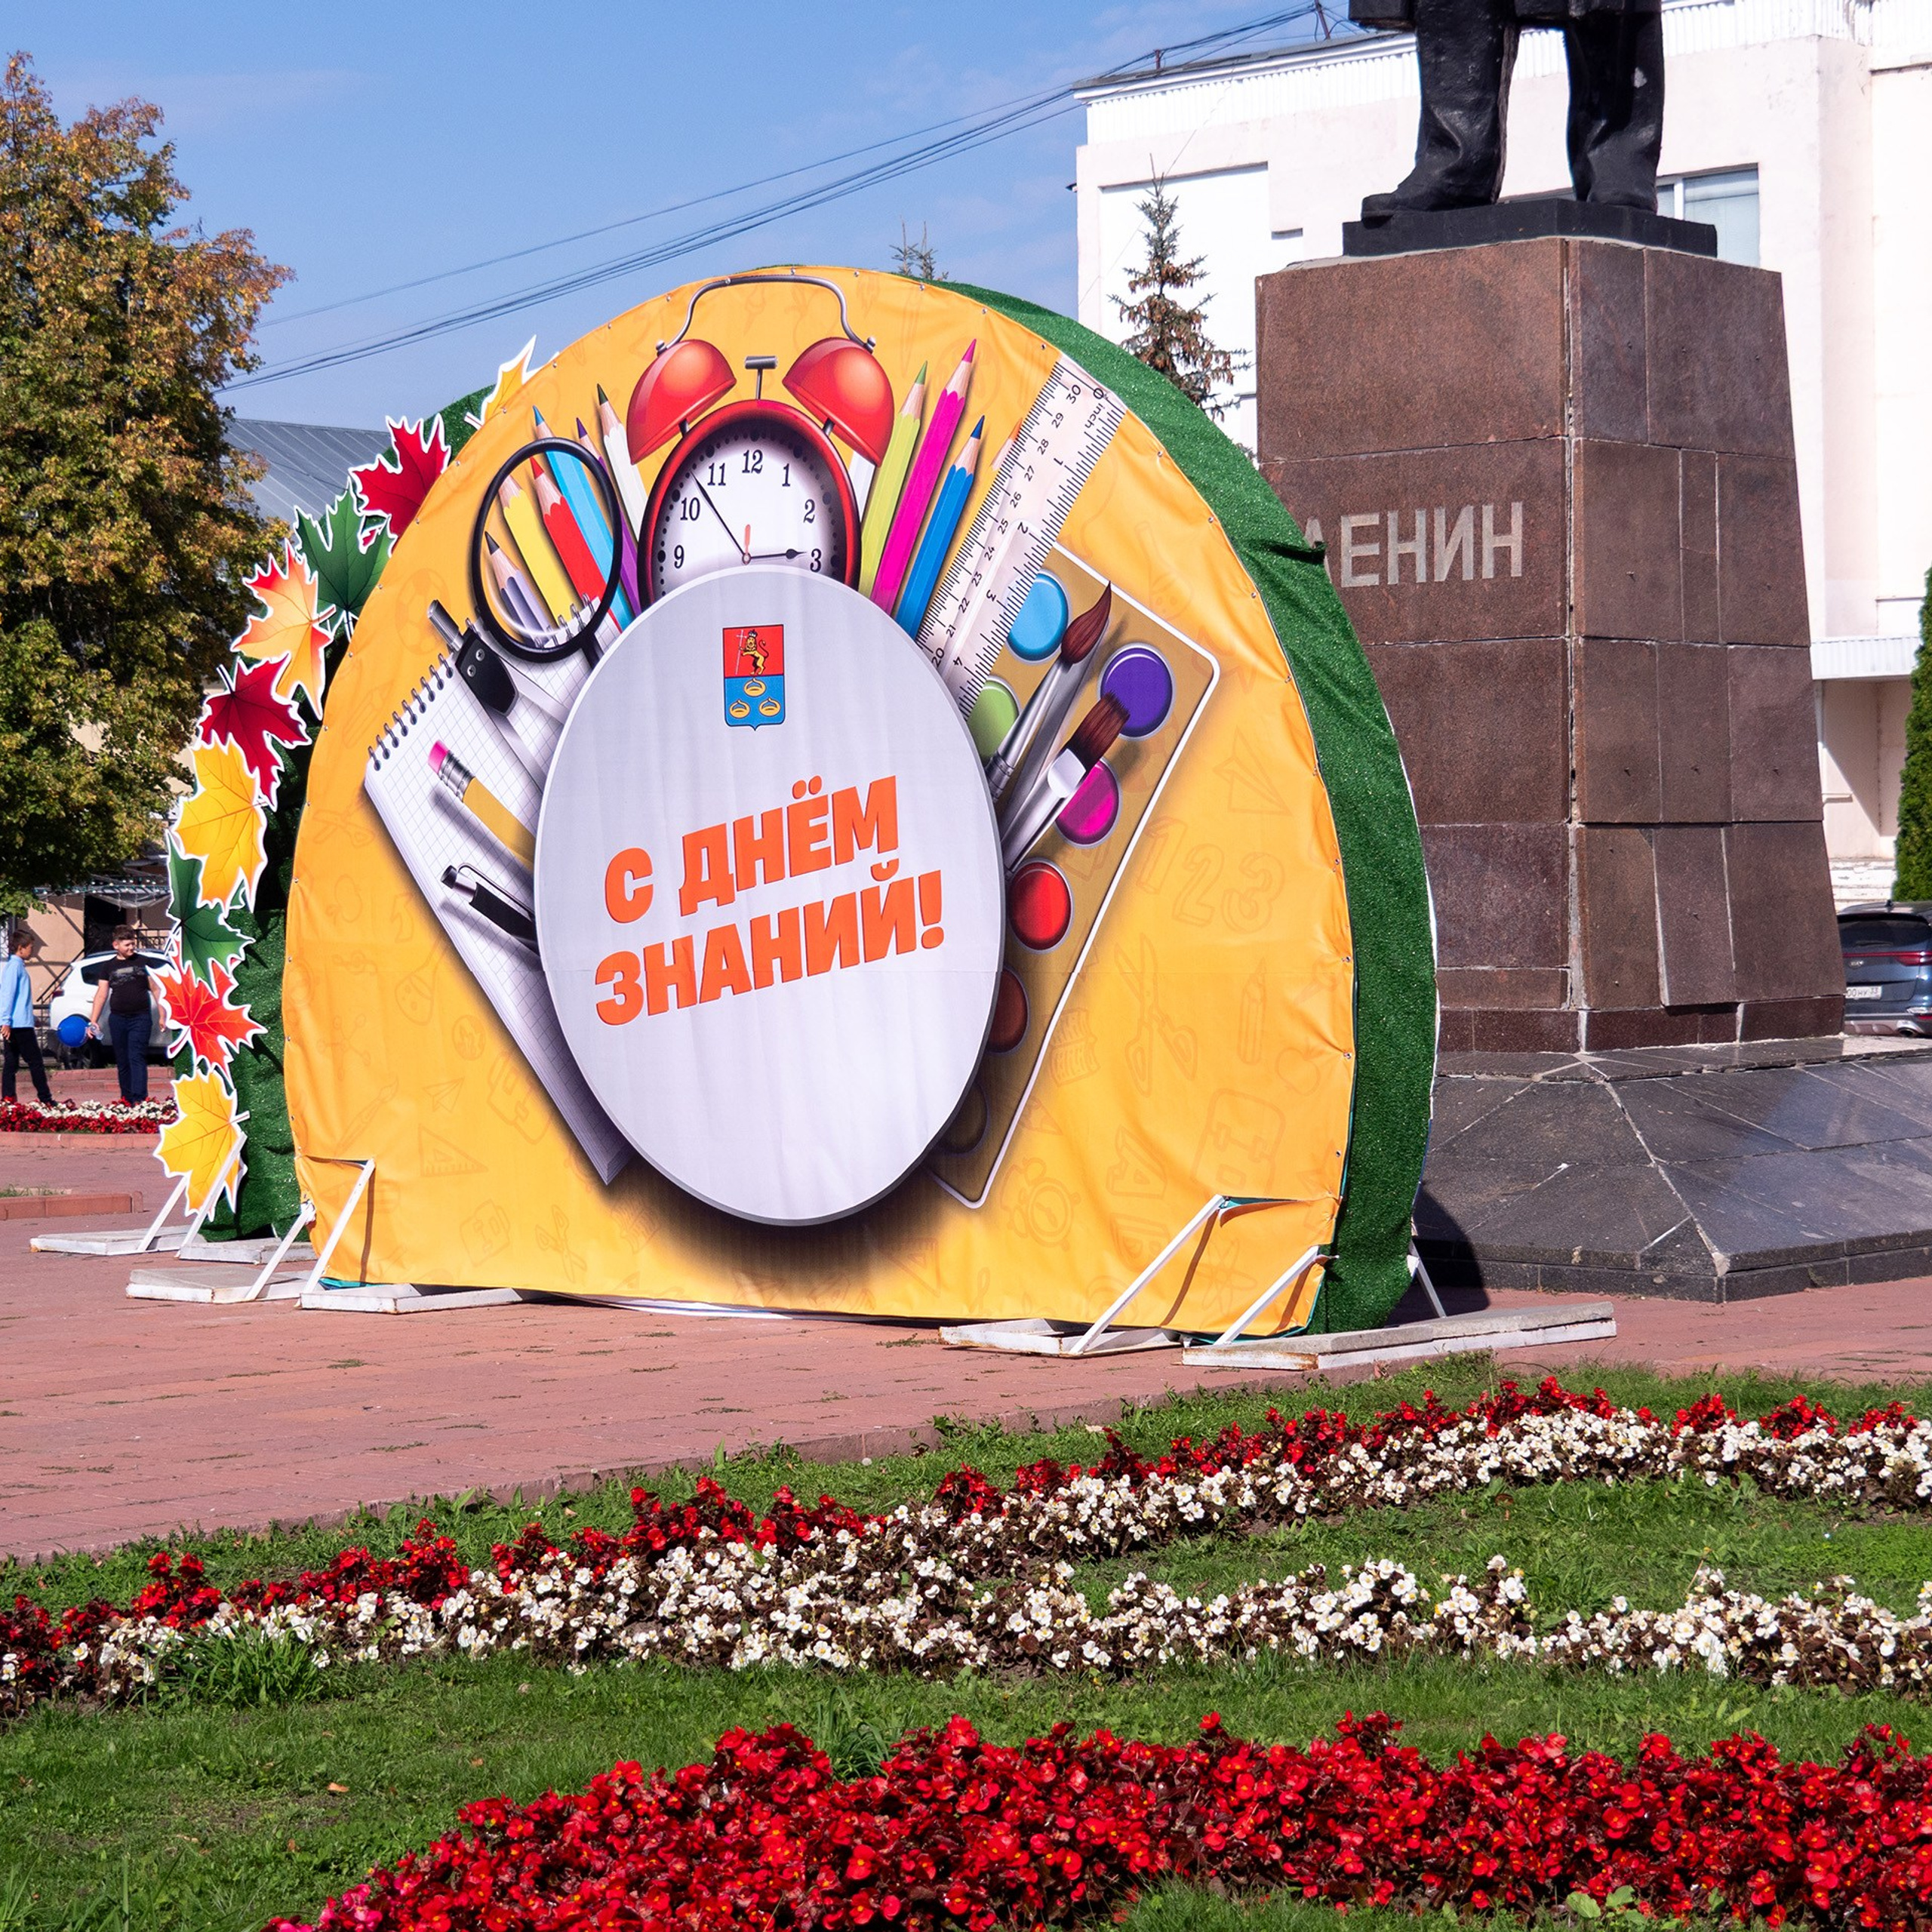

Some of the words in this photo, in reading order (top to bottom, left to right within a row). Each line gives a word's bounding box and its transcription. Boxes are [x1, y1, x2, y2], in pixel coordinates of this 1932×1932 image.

[1093, 388, 1104, 399] 0
[1084, 403, 1105, 429] inch
[742, 449, 763, 474] 12
[1054, 457, 1063, 466] 1
[707, 463, 726, 486] 11
[782, 463, 791, 487] 1
[680, 497, 700, 521] 10
[803, 499, 815, 523] 2
[931, 648, 945, 668] 20
[946, 624, 956, 638] 21
[958, 597, 970, 614] 22
[971, 571, 983, 587] 23
[984, 546, 995, 561] 24
[997, 518, 1009, 534] 25
[1010, 491, 1022, 509] 26
[1024, 465, 1035, 481] 27
[1037, 438, 1049, 455] 28
[1051, 412, 1063, 429] 29
[1066, 384, 1081, 404] 30
[1017, 521, 1029, 534] 2
[673, 545, 685, 568] 9
[810, 549, 822, 572] 3
[986, 589, 997, 602] 3
[952, 656, 963, 666] 4
[605, 847, 654, 924] С
[678, 775, 899, 916] ДНЁМ
[595, 858, 945, 1026] ЗНАНИЙ!
